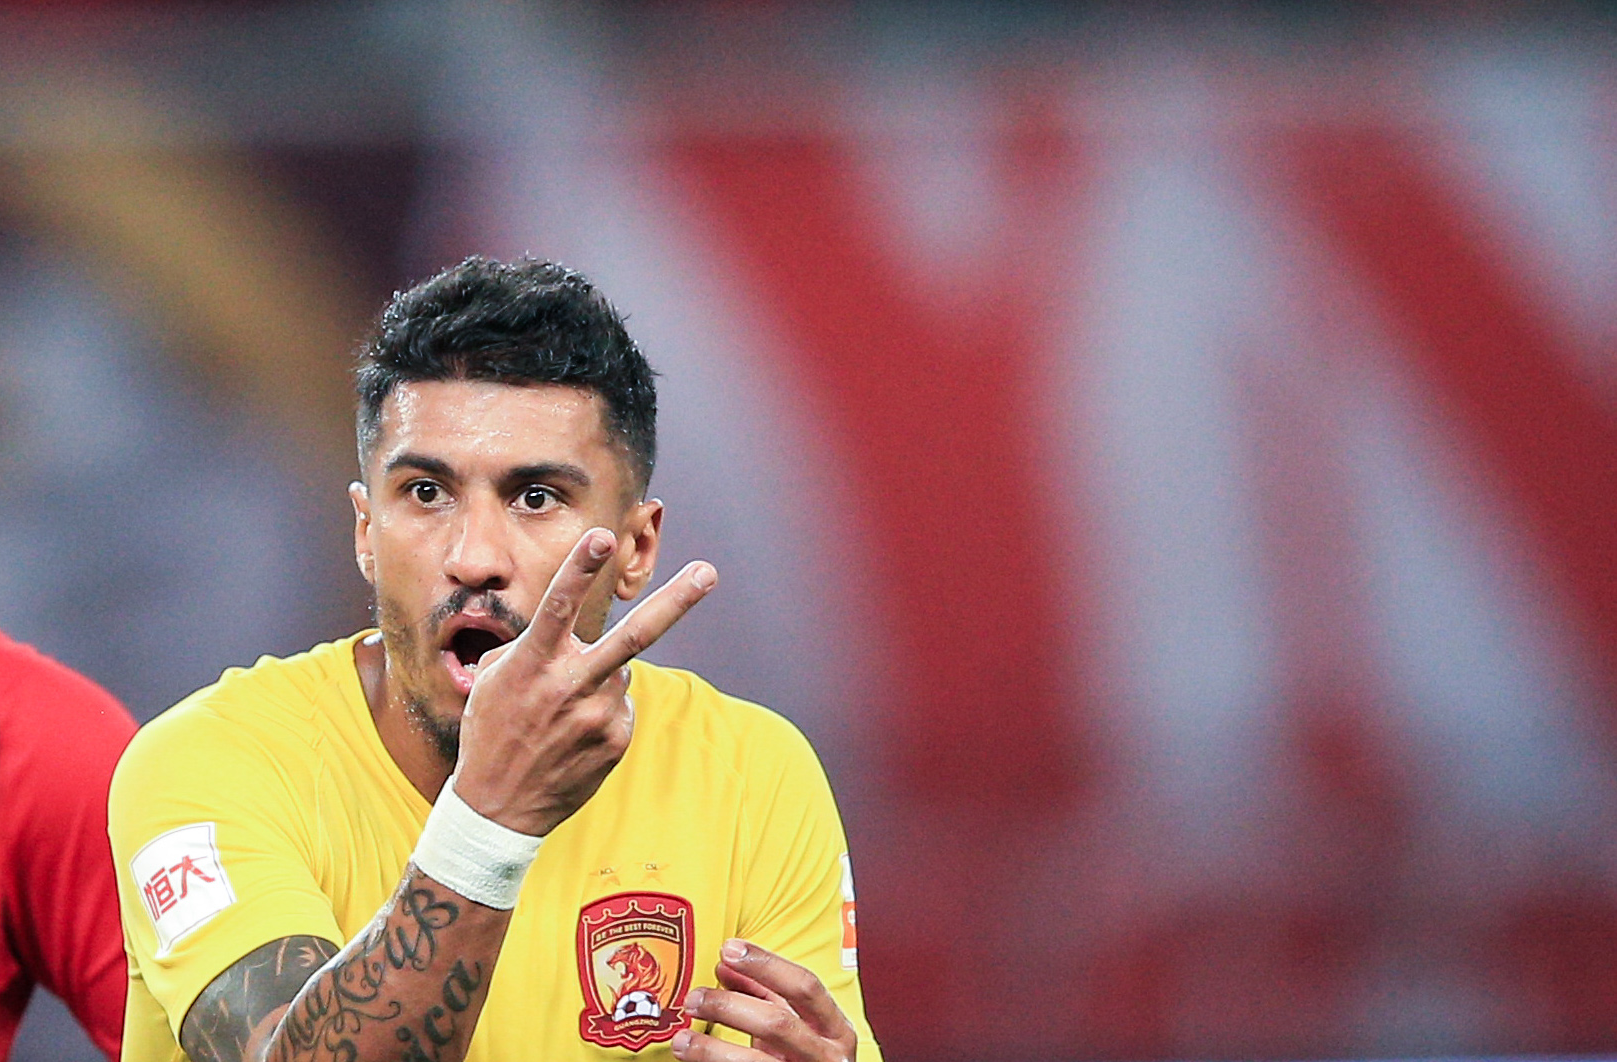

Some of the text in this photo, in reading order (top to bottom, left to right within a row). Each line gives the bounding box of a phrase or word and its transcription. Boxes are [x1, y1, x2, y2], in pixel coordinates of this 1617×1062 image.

[143, 855, 216, 922] 恒大
[595, 923, 675, 942] BE THE BEST FOREVER
[613, 1018, 660, 1032] GUANGZHOU
